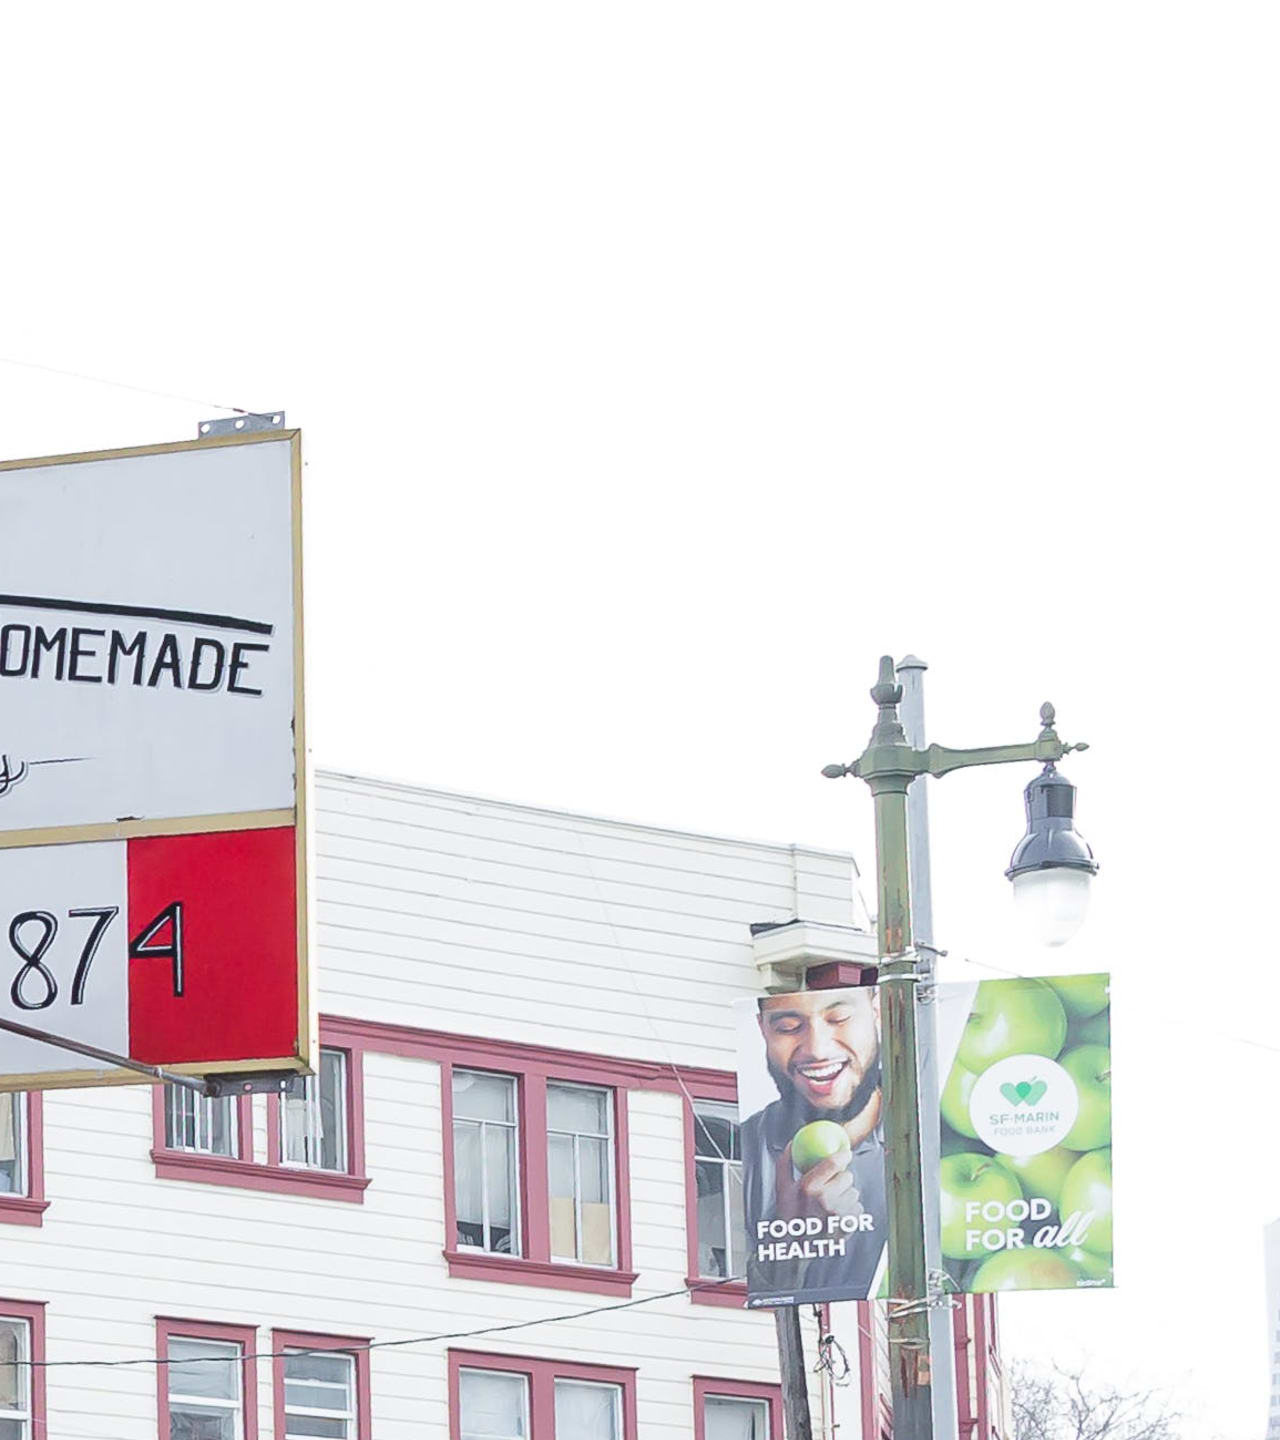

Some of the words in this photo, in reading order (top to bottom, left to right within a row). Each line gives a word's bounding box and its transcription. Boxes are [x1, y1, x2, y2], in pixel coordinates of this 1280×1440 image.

[994, 1127, 1023, 1136] FOOD
[1026, 1125, 1057, 1135] BANK
[965, 1197, 1052, 1223] FOOD
[757, 1217, 823, 1239] FOOD
[827, 1213, 875, 1235] FOR
[966, 1227, 1025, 1251] FOR
[1032, 1210, 1097, 1249] all
[758, 1238, 846, 1262] HEALTH
